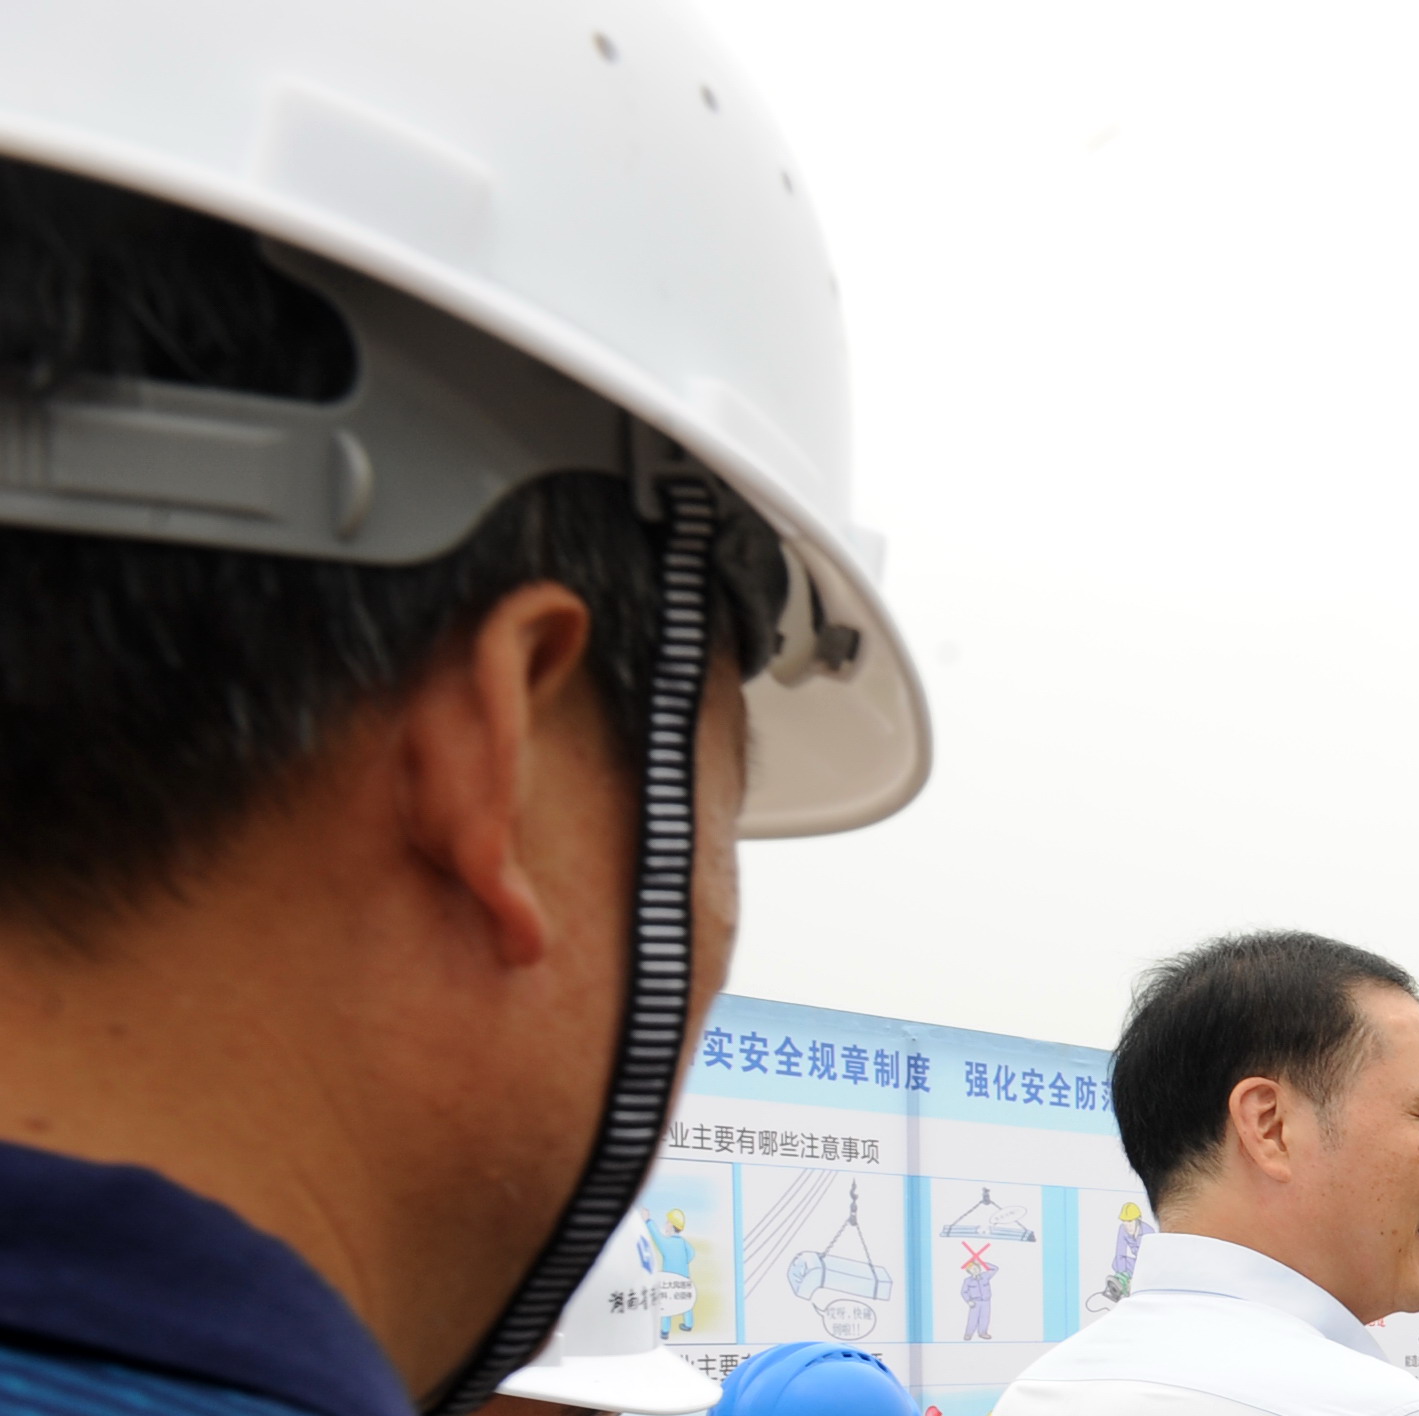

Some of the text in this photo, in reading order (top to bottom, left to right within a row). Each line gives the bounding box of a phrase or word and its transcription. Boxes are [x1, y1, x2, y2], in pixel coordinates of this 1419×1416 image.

[692, 1026, 932, 1093] 实安全规章制度
[661, 1121, 880, 1164] 业主要有哪些注意事项
